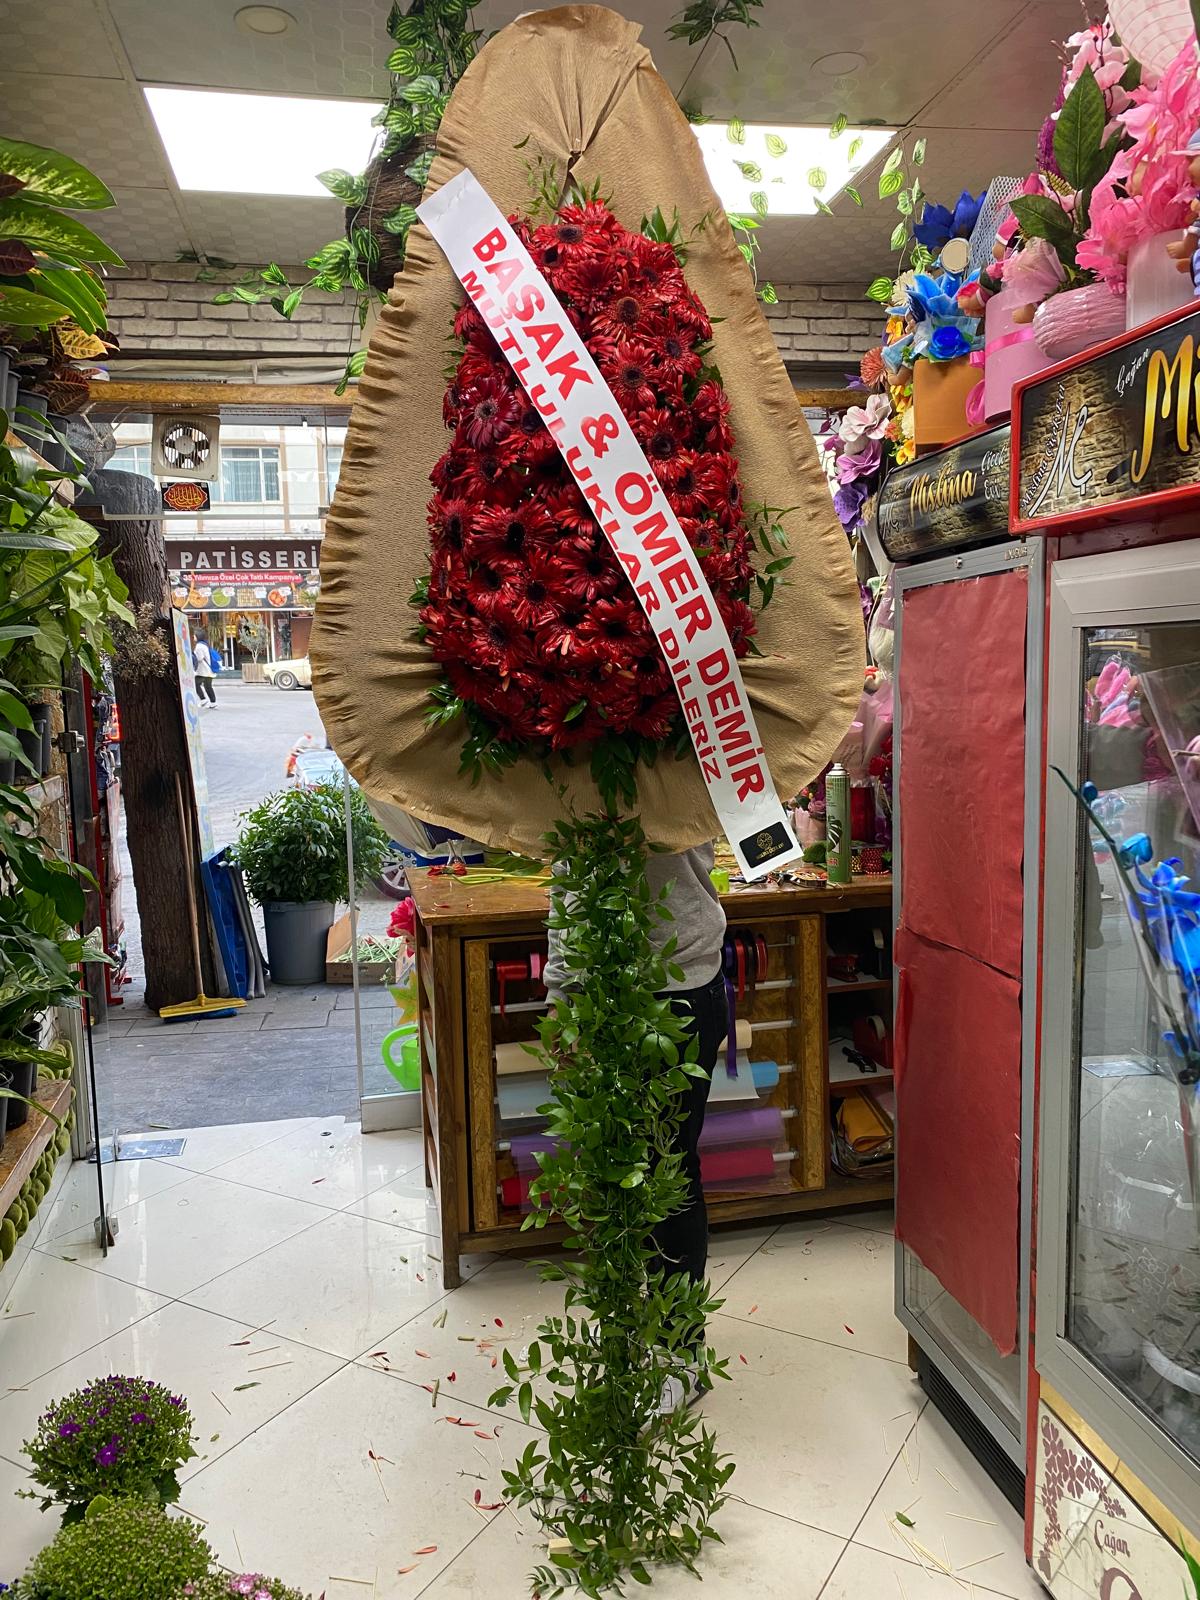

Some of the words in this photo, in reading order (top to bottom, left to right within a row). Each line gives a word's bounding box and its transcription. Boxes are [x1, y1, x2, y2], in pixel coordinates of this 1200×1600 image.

[180, 546, 317, 568] PATİSSERİ
[460, 270, 661, 617] MUTLULUKLAR
[658, 628, 722, 784] DİLERİZ
[472, 227, 593, 401] BAŞAK
[580, 413, 620, 459] &
[615, 472, 713, 644] ÖMER
[697, 647, 765, 802] DEMİR
